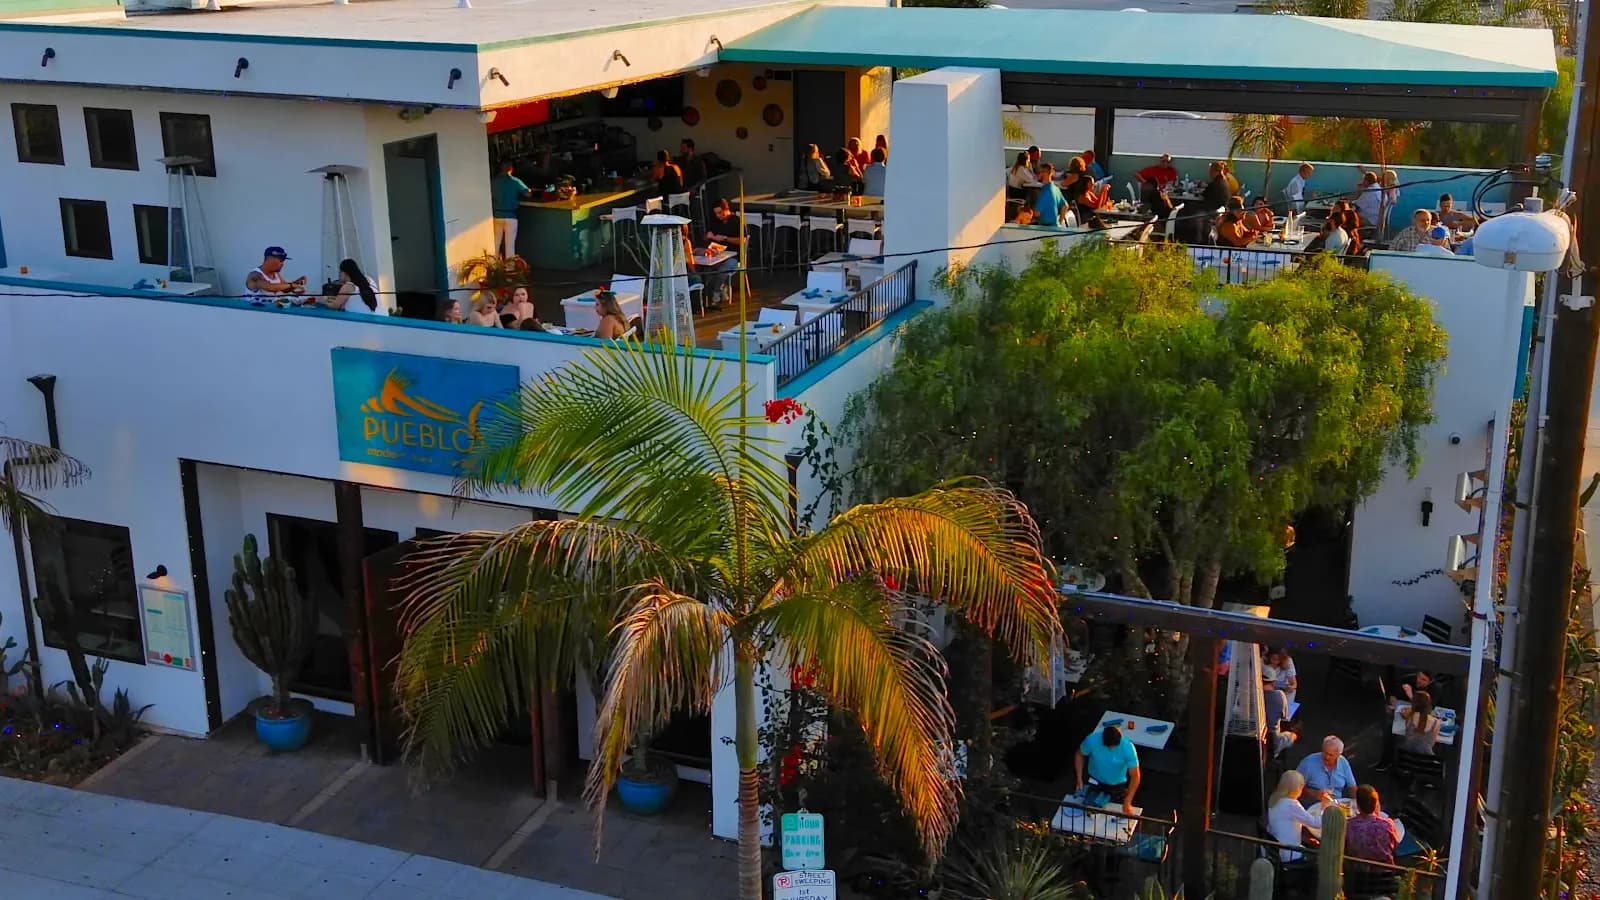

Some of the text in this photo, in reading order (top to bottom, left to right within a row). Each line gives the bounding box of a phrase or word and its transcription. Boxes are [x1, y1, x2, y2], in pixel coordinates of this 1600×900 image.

[363, 416, 474, 453] PUEBLO
[800, 819, 820, 828] HOUR
[785, 835, 820, 845] PARKING
